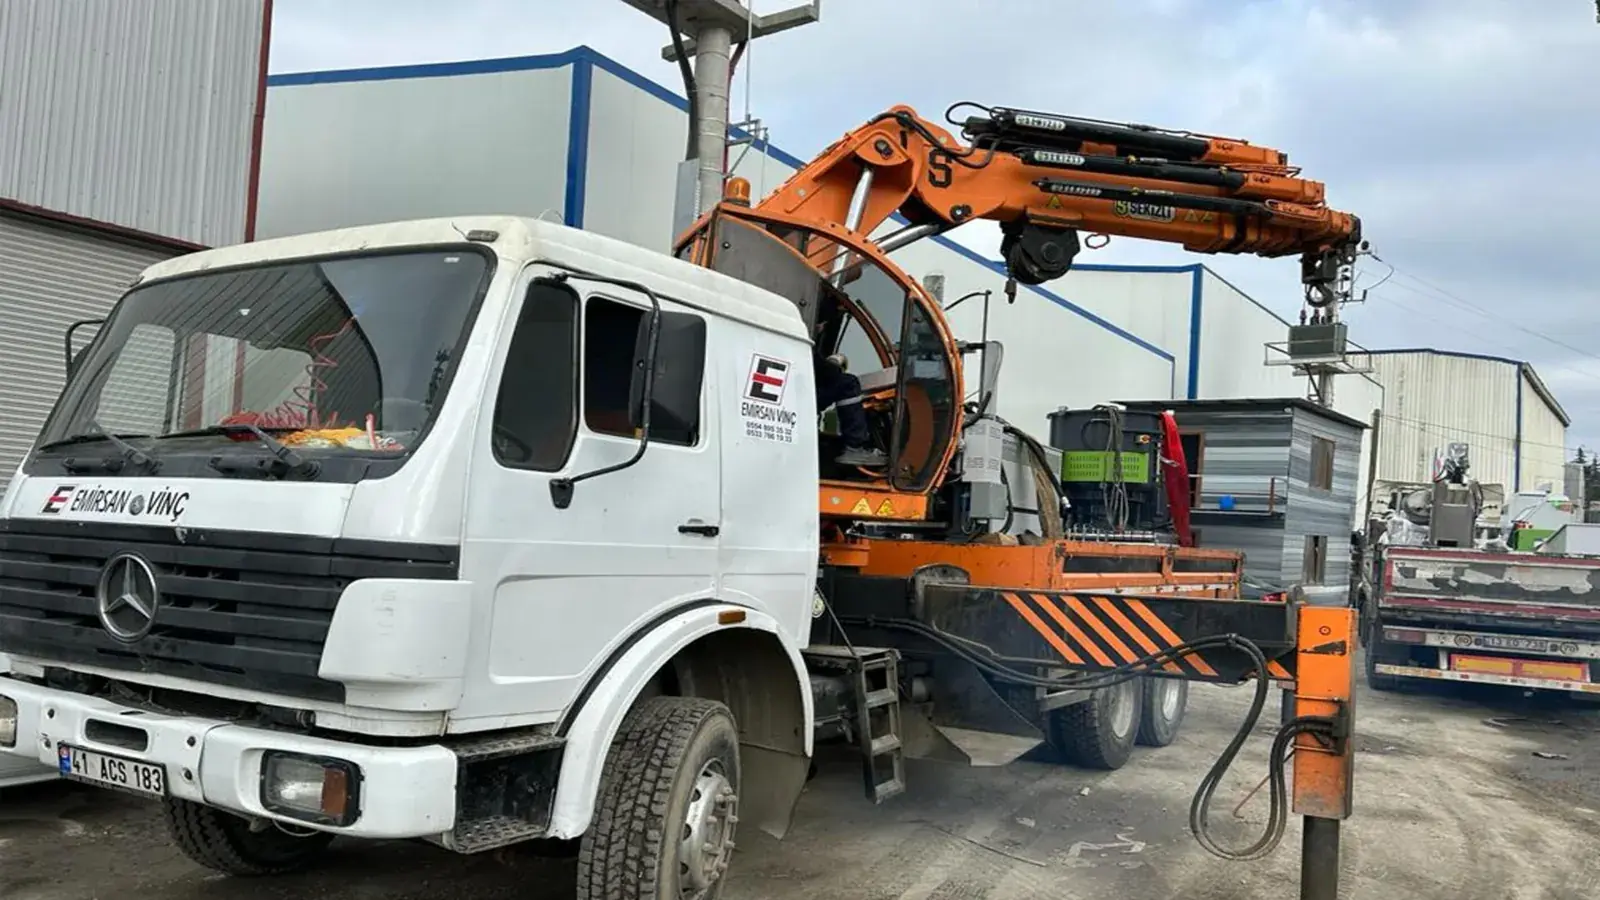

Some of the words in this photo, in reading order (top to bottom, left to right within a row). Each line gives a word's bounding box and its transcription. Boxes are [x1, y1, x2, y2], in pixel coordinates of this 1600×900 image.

[70, 484, 132, 514] EMİRSAN
[146, 486, 190, 522] VİNÇ
[72, 749, 88, 775] 41
[100, 757, 127, 784] ACS
[134, 765, 162, 792] 183
